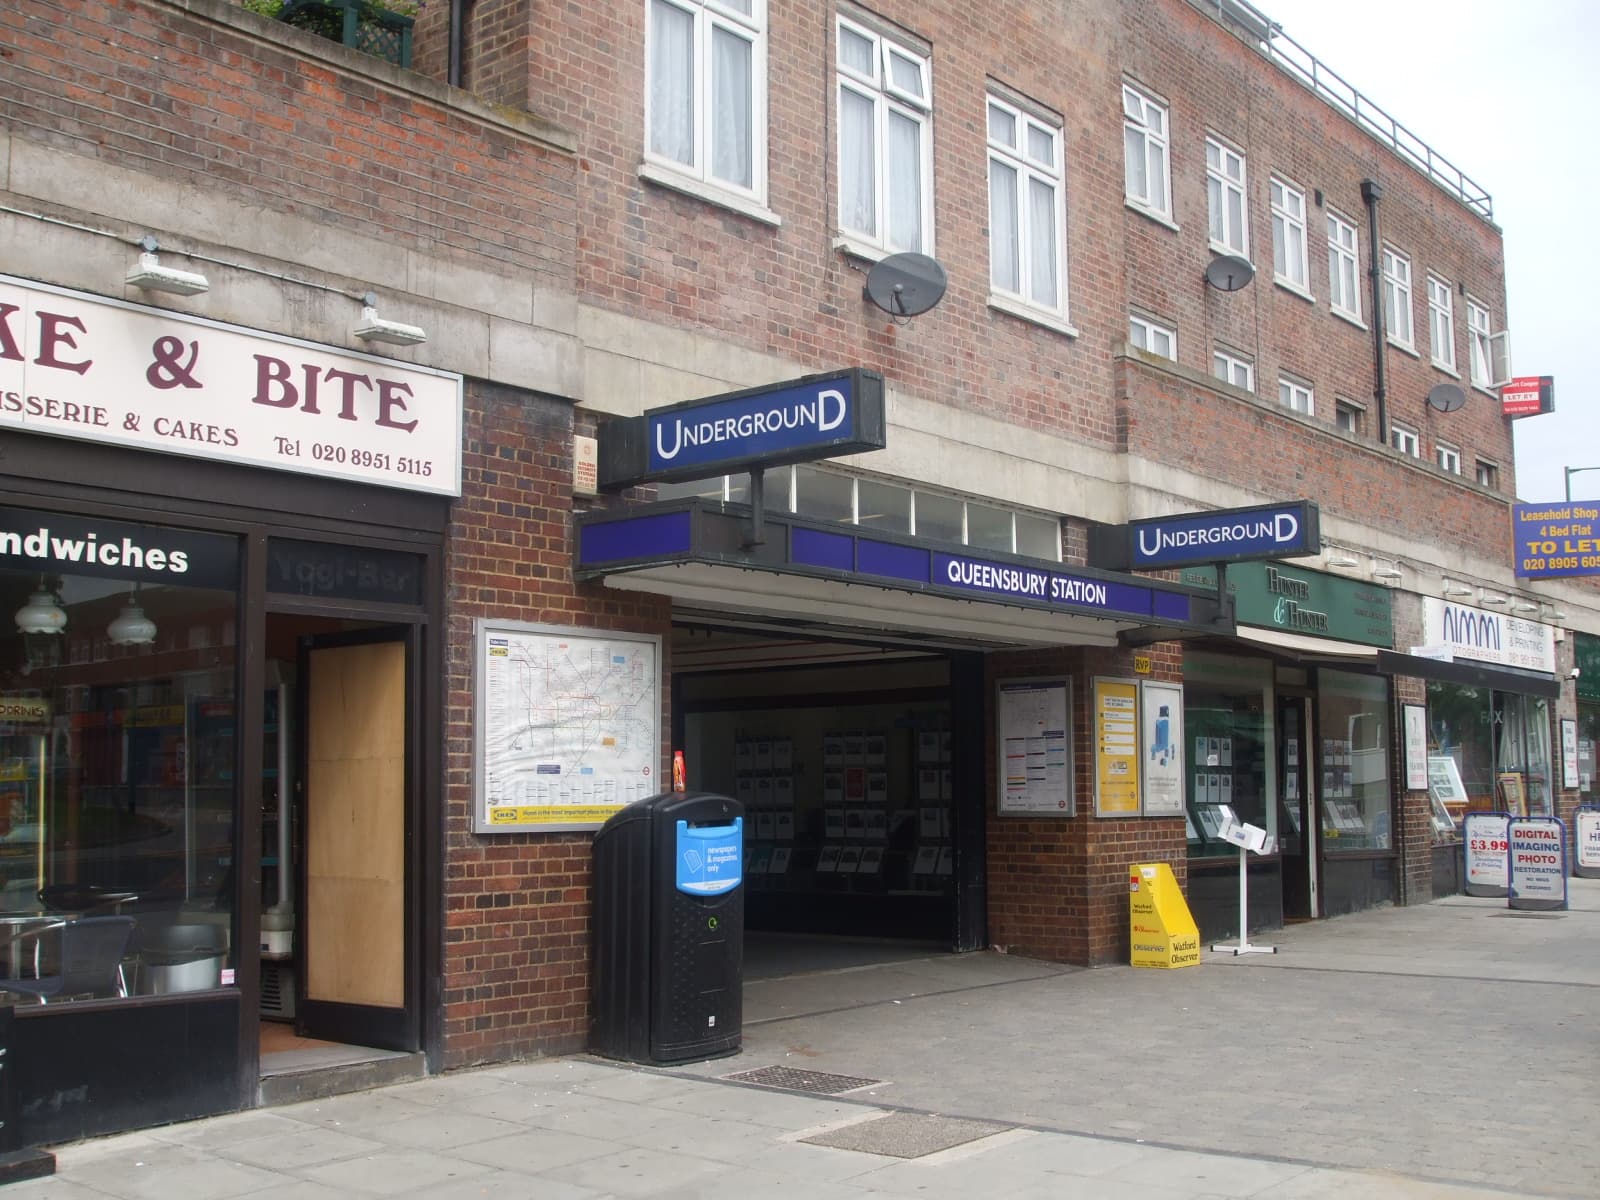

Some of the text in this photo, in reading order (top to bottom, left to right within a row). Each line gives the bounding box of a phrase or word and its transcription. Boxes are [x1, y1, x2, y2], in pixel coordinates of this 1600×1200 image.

[145, 335, 203, 390] &
[252, 353, 418, 433] BITE
[122, 411, 141, 432] &
[153, 417, 239, 447] CAKES
[656, 389, 846, 460] UNDERGROUND
[274, 436, 432, 478] Tel 020 8951 5115
[1521, 507, 1598, 521] Leasehold Shop
[1139, 513, 1298, 556] UNDERGROUND
[1540, 524, 1592, 537] 4 Bed Flat
[0, 529, 189, 574] ndwiches
[1526, 539, 1600, 554] TO LET
[1523, 558, 1546, 570] 020
[1549, 557, 1578, 569] 8905
[948, 560, 1106, 605] QUEENSBURY STATION
[1265, 565, 1310, 600] HUNTER
[1273, 597, 1285, 624] &
[1285, 599, 1328, 632] HUNTER
[1443, 606, 1500, 650] NIMMI
[1505, 619, 1545, 638] DEVELOPING
[1515, 639, 1544, 653] PRINTING
[1136, 658, 1149, 670] RVP
[1514, 830, 1558, 840] DIGITAL
[1470, 840, 1508, 851] £3.99
[1512, 842, 1560, 852] IMAGING
[1517, 855, 1557, 864] PHOTO
[1514, 866, 1561, 875] RESTORATION
[1173, 940, 1197, 952] Watford
[1171, 952, 1198, 964] Observer
